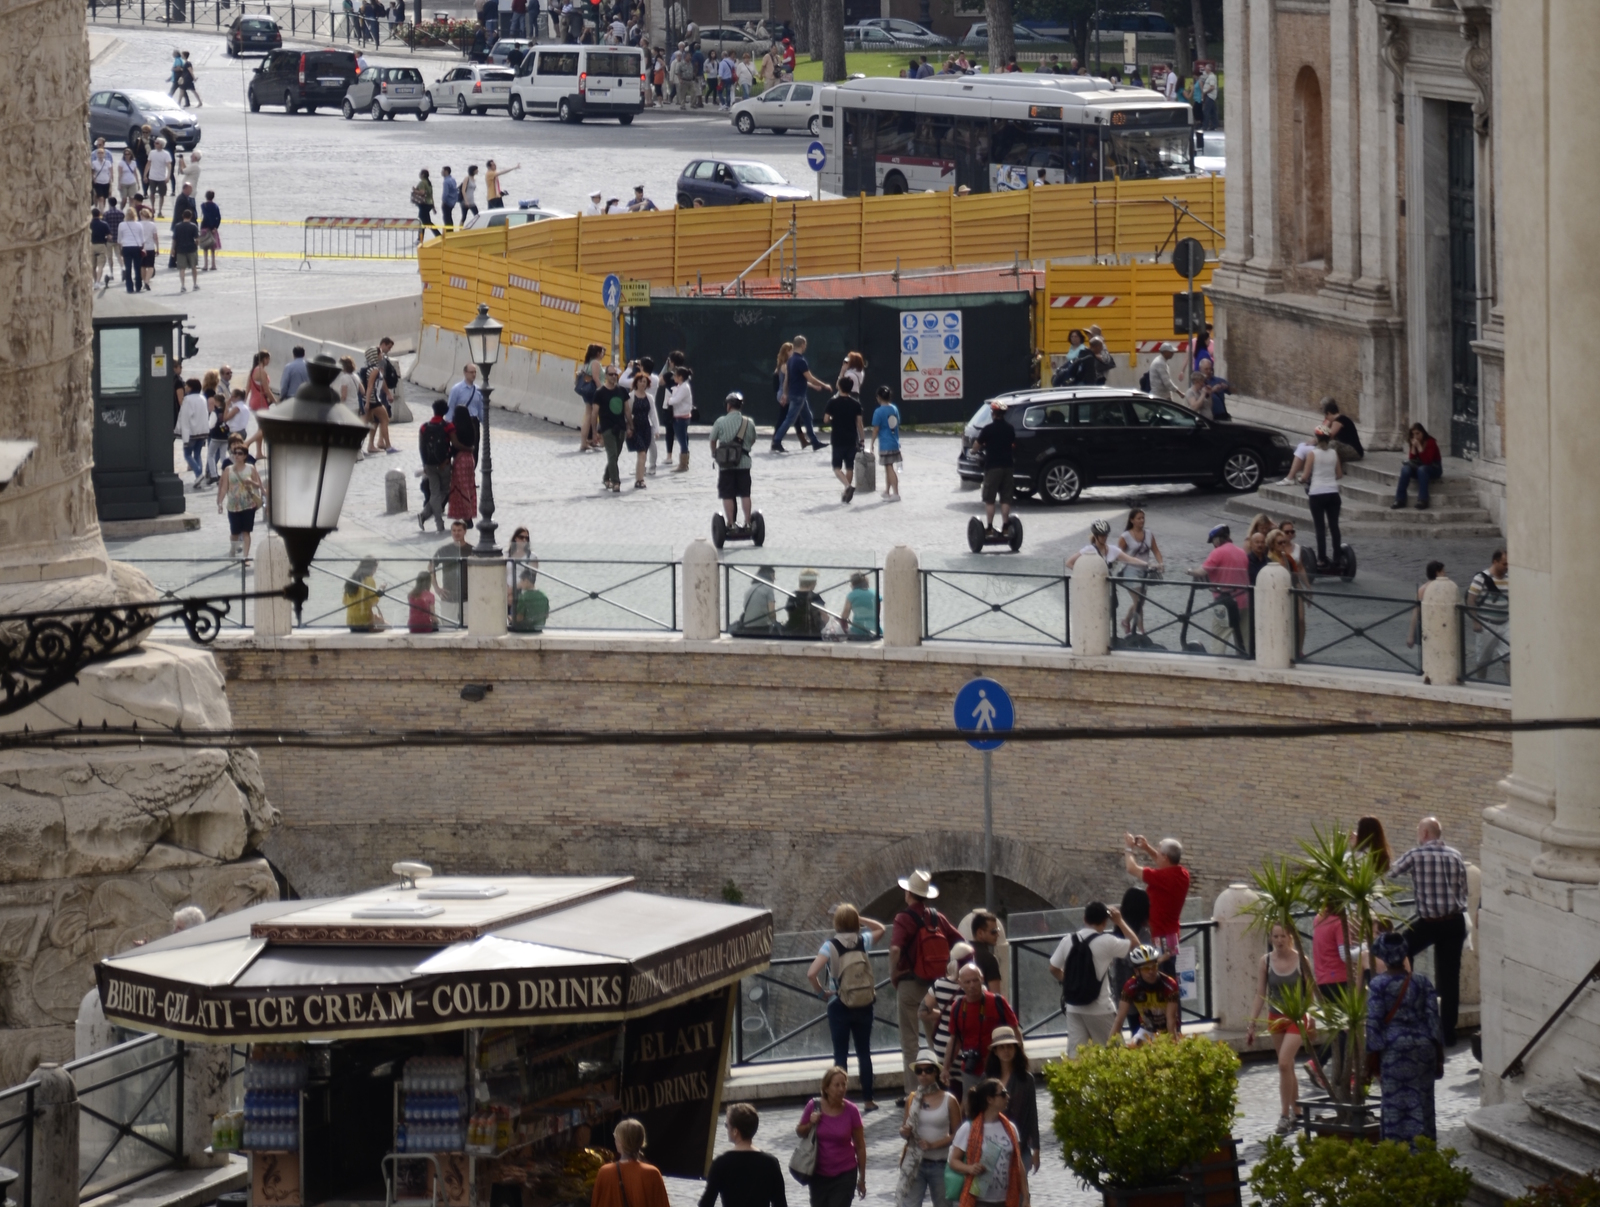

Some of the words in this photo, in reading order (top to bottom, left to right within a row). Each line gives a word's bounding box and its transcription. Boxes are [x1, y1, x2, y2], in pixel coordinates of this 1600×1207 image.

[517, 975, 622, 1010] DRINKS
[632, 1021, 716, 1063] ELATI
[620, 1084, 650, 1115] OLD
[653, 1071, 708, 1108] DRINKS
